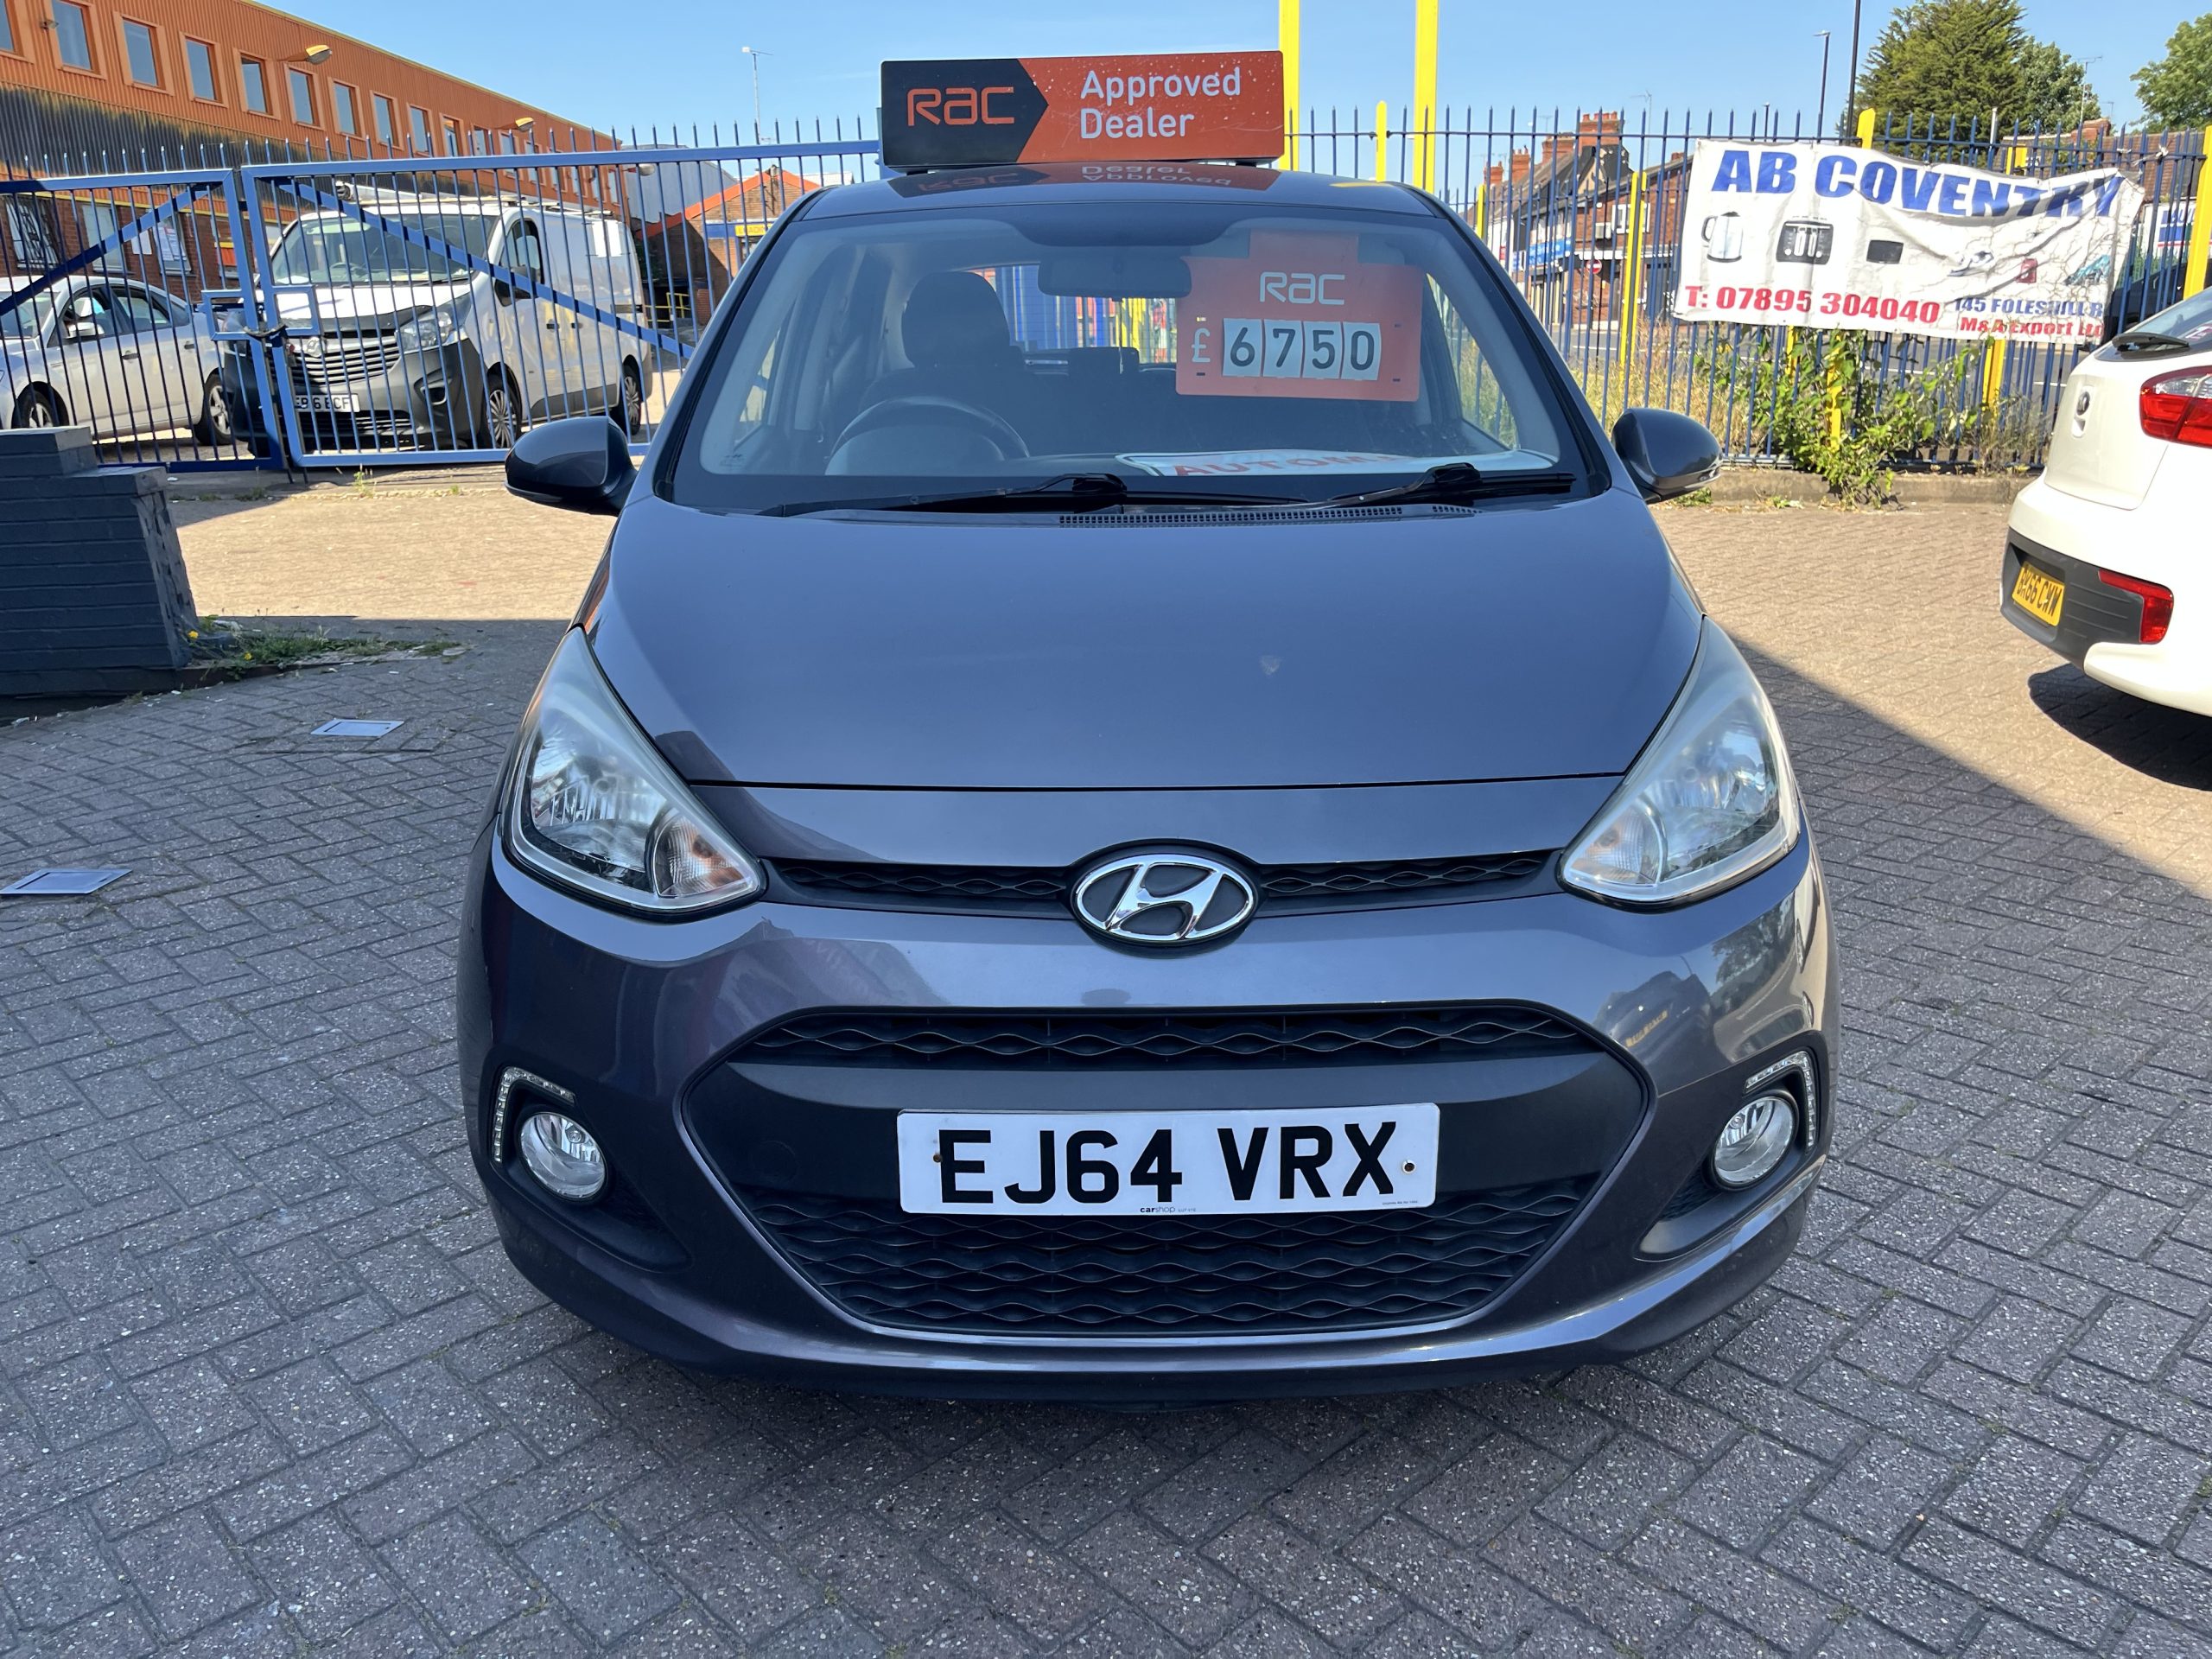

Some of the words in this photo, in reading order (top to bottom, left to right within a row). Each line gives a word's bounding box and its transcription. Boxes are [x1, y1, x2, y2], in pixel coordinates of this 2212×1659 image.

[1080, 67, 1241, 105] Approved
[906, 86, 1015, 127] RAC
[1080, 107, 1195, 140] Dealer
[1711, 149, 1796, 195] AB
[1815, 154, 2125, 218] COVENTRY
[1259, 271, 1345, 305] RAC
[1684, 285, 1708, 310] T:
[1716, 286, 1812, 315] 07895
[1820, 291, 1941, 325] 304040
[1230, 327, 1375, 371] 6750
[938, 1128, 1183, 1205] EJ64
[1217, 1121, 1397, 1201] VRX
